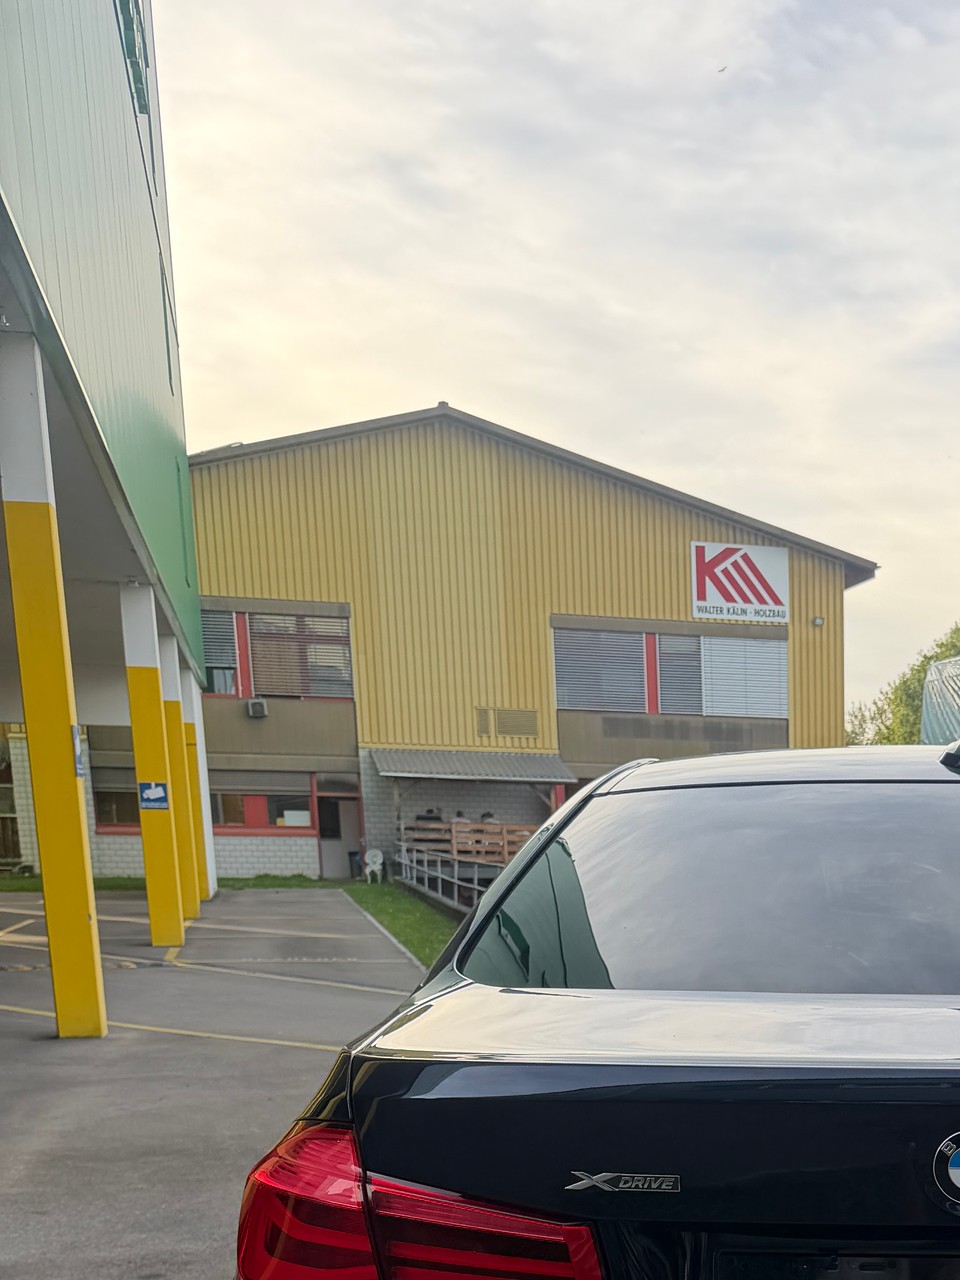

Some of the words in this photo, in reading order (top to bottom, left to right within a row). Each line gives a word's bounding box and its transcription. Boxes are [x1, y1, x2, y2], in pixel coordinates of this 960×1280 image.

[696, 605, 724, 615] WALTER
[727, 605, 748, 616] KÄLIN
[754, 608, 786, 618] HOLZBAU
